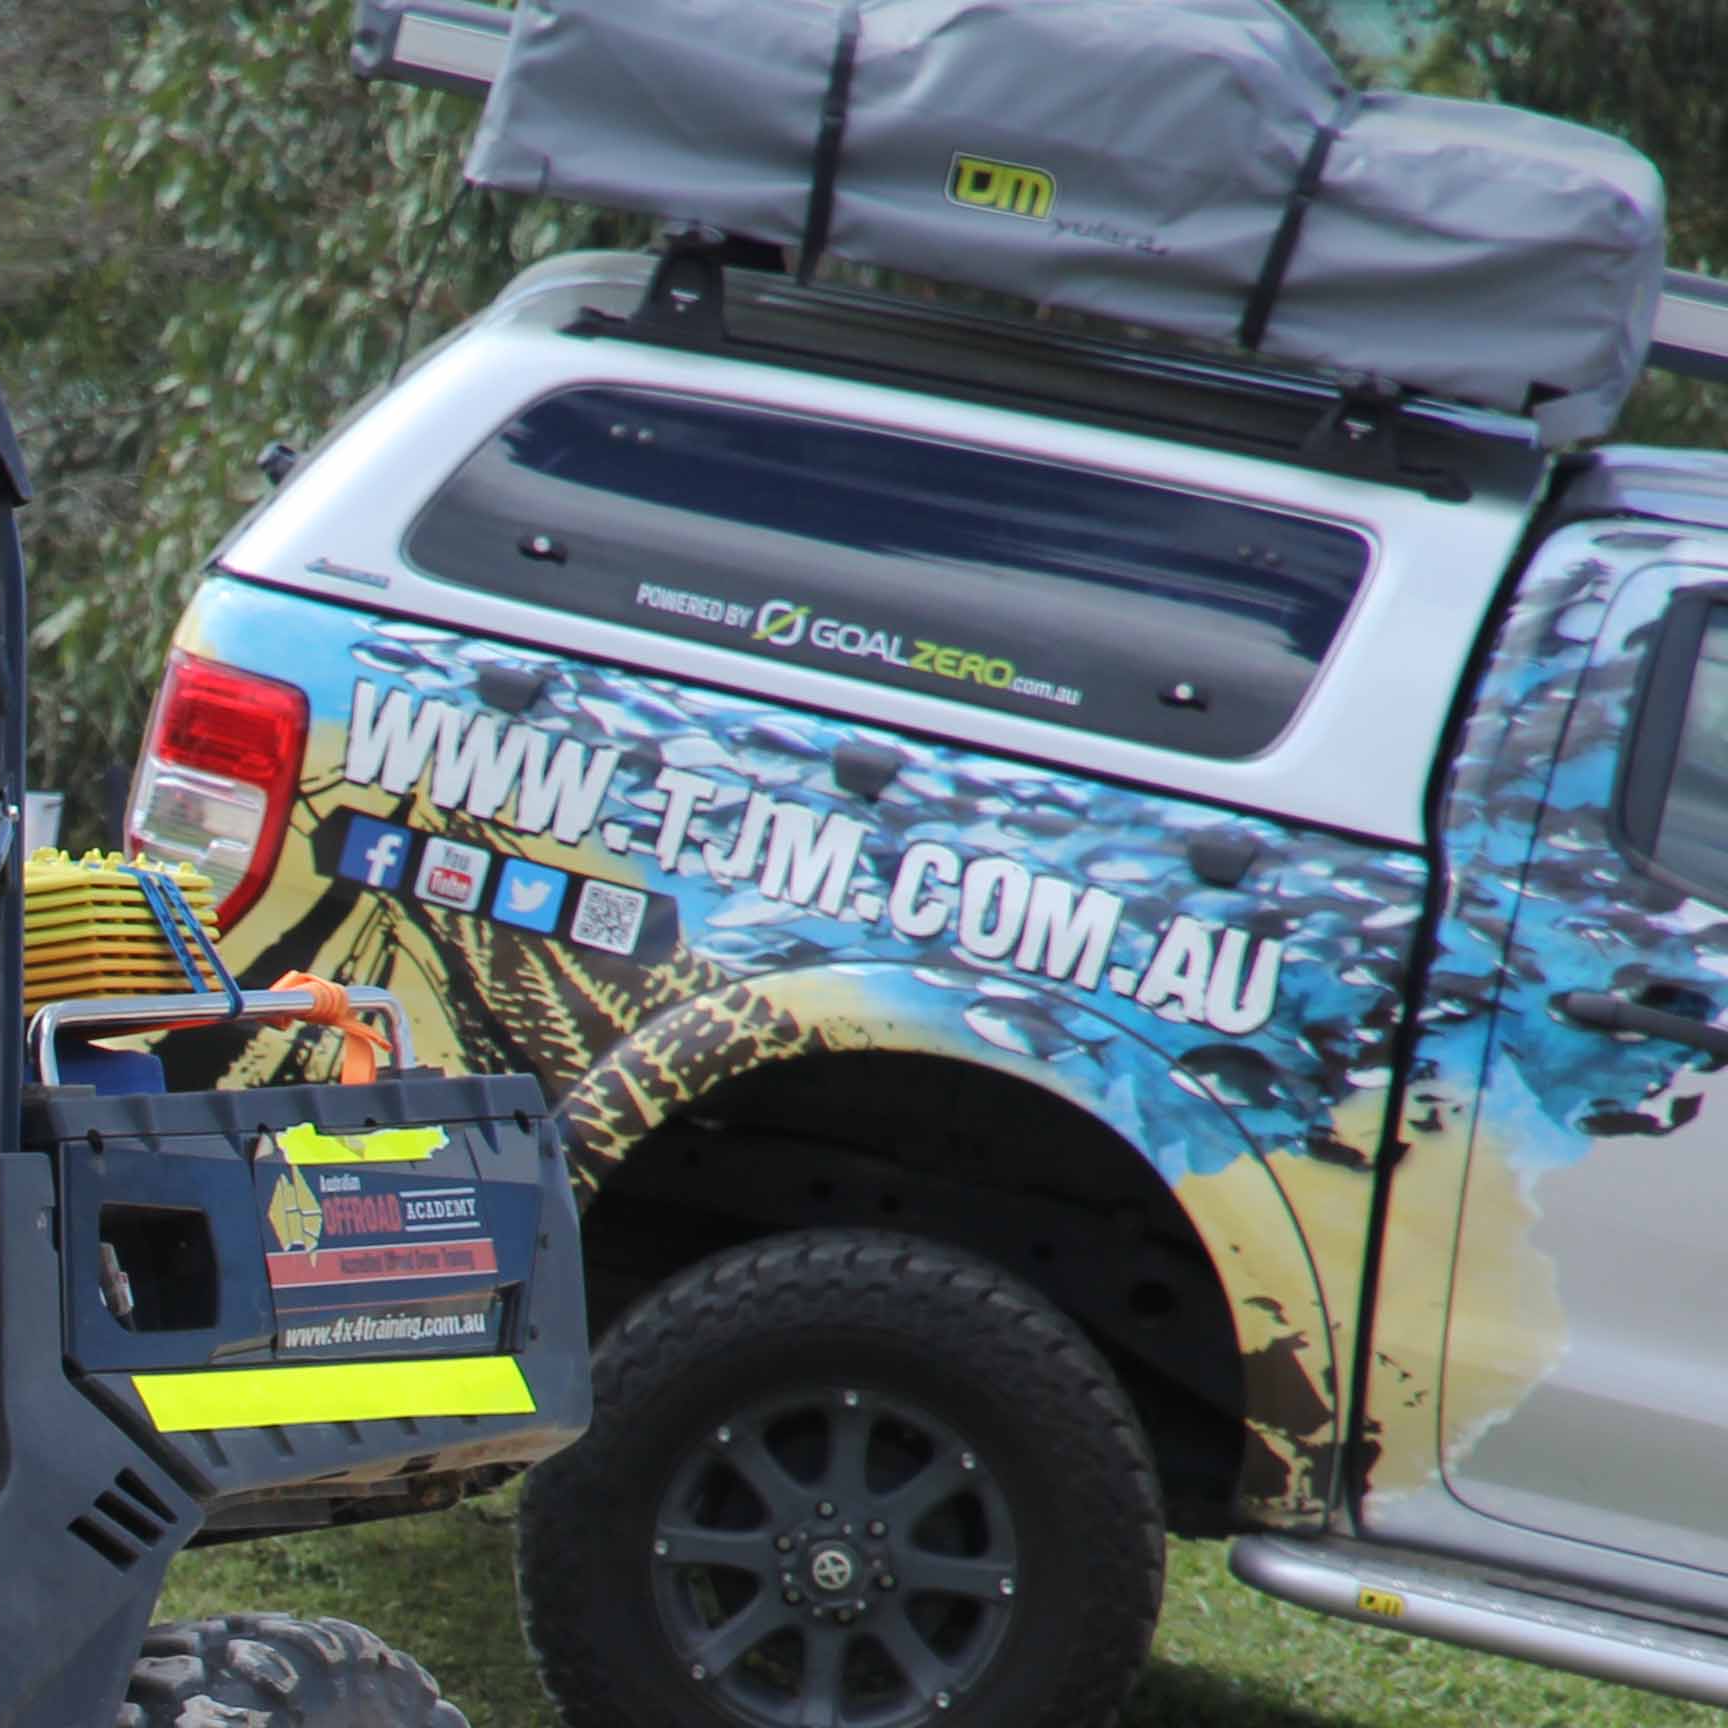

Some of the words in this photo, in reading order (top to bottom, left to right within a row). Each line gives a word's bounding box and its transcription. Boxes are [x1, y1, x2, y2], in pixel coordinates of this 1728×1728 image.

[636, 583, 724, 623] POWERED
[723, 603, 754, 628] BY
[341, 679, 1285, 1035] WWW.TJM.COM.AU
[322, 1193, 402, 1237] OFFROAD
[405, 1197, 476, 1220] ACADEMY
[285, 1311, 487, 1348] www.4x4training.com.au
